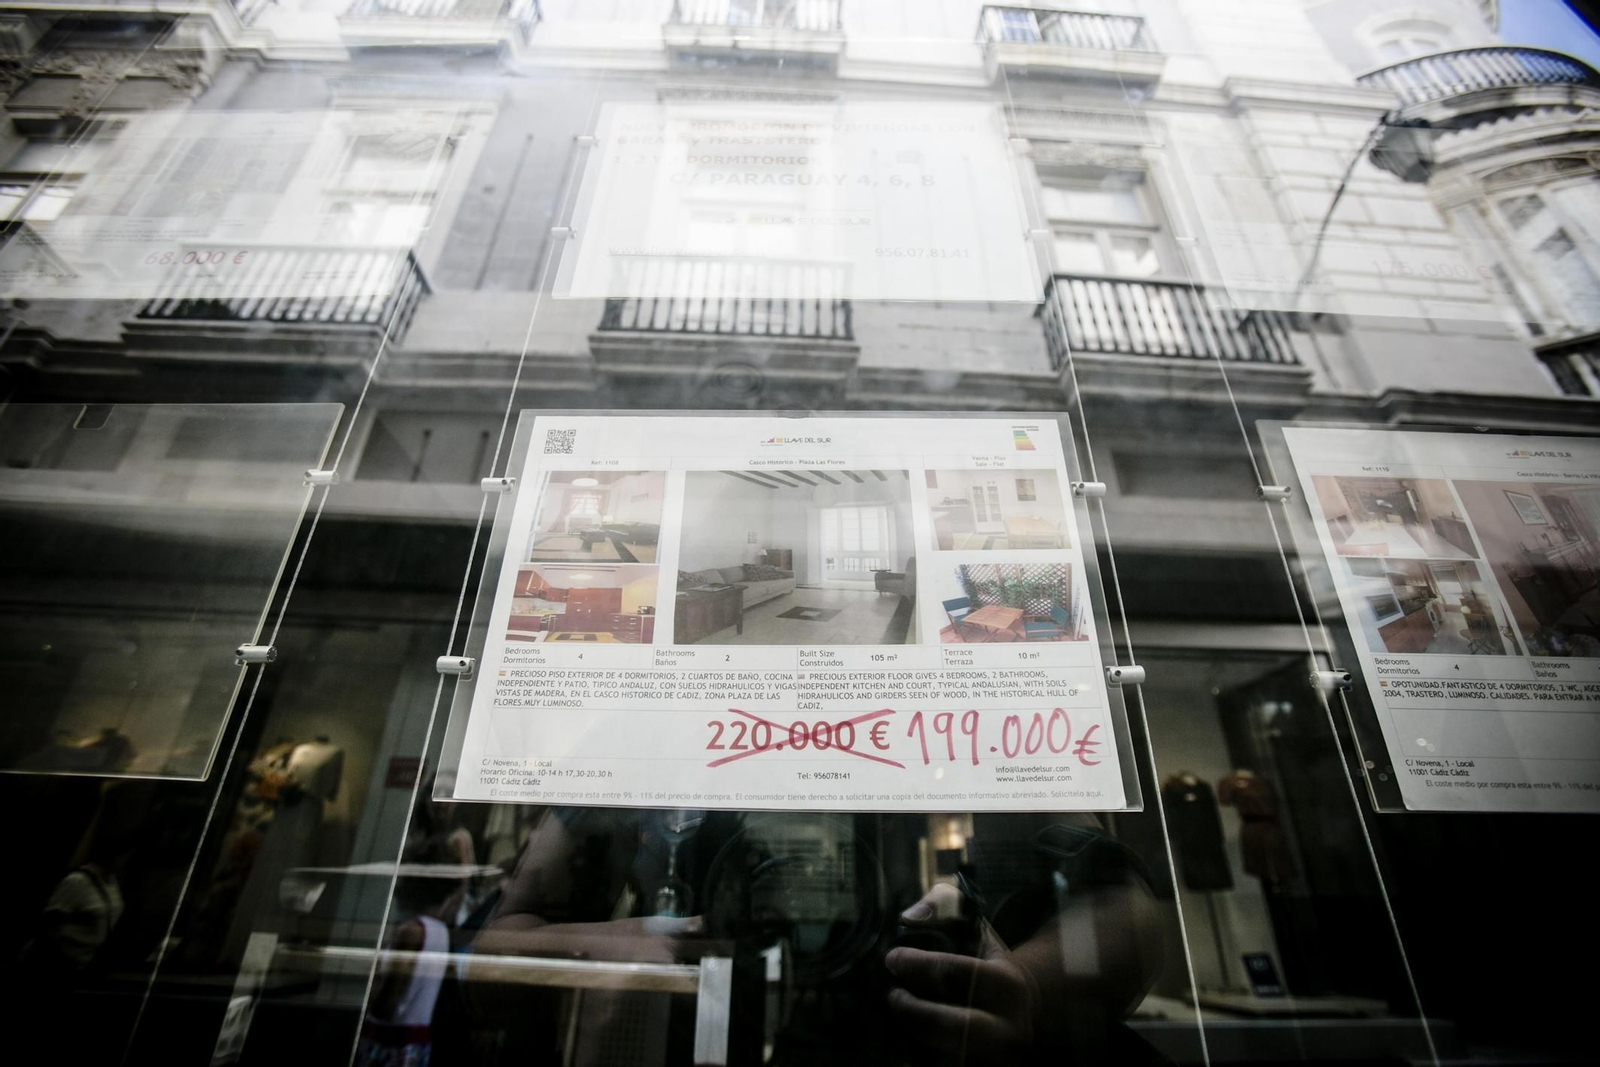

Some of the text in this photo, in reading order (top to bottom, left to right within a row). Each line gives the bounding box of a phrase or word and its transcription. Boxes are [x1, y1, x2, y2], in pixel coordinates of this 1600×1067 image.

[670, 172, 936, 190] C/ PARAGUAY 4, 6, 8
[874, 248, 970, 258] 956.07.81.41
[145, 251, 249, 265] 68.000 €
[625, 672, 678, 680] DORMITORIOS,
[1000, 671, 1049, 679] BATHROOMS,
[907, 682, 934, 690] COURT,
[1506, 683, 1558, 692] DORMITORIOS,
[536, 690, 568, 698] MADERA,
[677, 692, 701, 700] CADIZ,
[1383, 690, 1404, 698] 2004,
[1406, 690, 1447, 698] TRASTERO,
[798, 702, 823, 710] CADIZ,
[706, 720, 890, 751] 220.000 €
[907, 708, 1102, 766] 199.000 €
